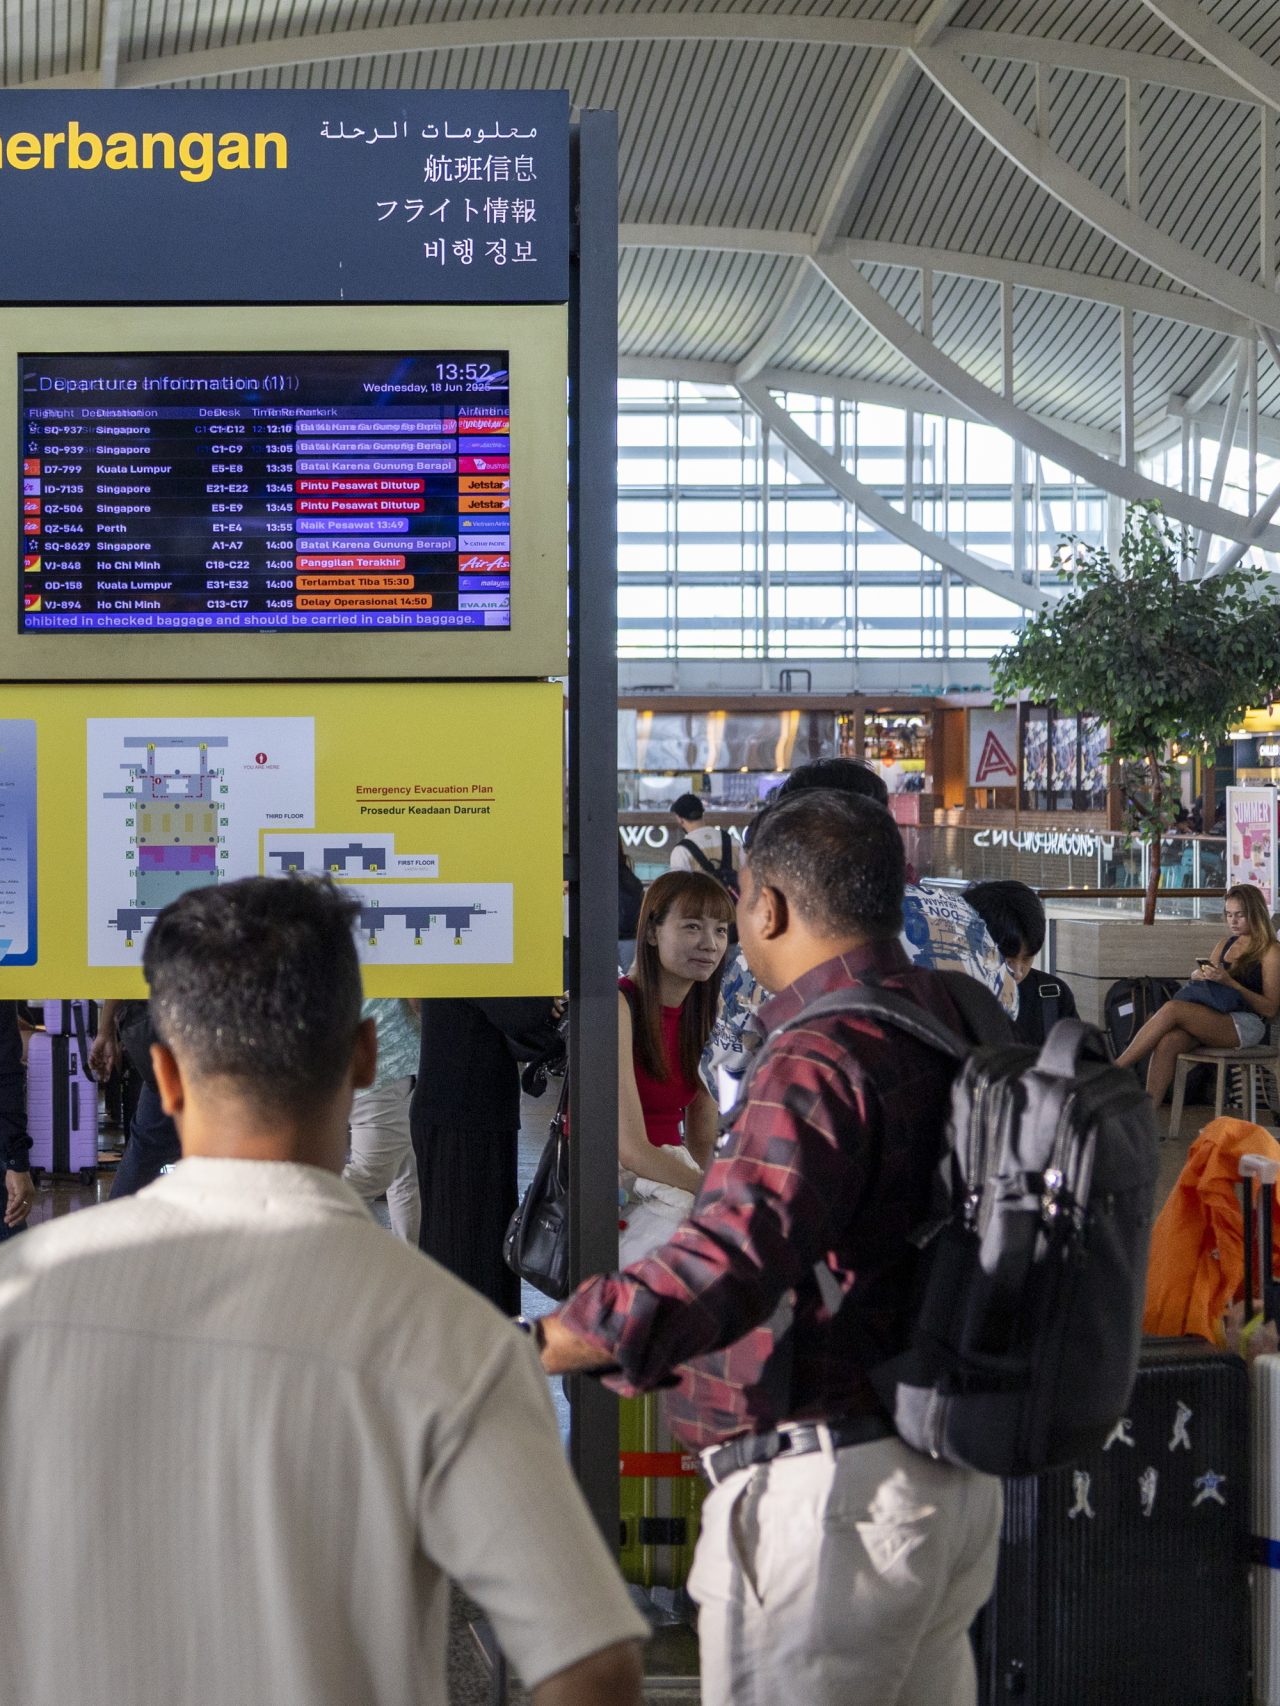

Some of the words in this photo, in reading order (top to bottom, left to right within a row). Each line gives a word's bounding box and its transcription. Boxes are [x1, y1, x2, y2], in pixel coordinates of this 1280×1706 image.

[321, 121, 406, 144] الرحلة
[422, 122, 536, 143] معلومات
[424, 155, 536, 182] 航班信息
[377, 197, 536, 223] フライト情報
[424, 238, 473, 265] 비행
[485, 238, 537, 265] 정보
[436, 364, 492, 381] 13:52
[363, 384, 427, 393] Wednesday,
[431, 383, 441, 391] 18
[468, 481, 506, 489] Jetstar
[468, 500, 506, 508] Jetstar
[45, 542, 90, 551] SQ-8629
[97, 543, 151, 551] Singapore
[266, 541, 293, 549] 14:00
[301, 541, 329, 549] Batal
[373, 541, 413, 549] Gunung
[134, 561, 160, 569] Minh
[206, 561, 249, 569] C18-C22
[301, 559, 353, 567] Panggilan
[131, 582, 172, 590] Lumpur
[266, 580, 293, 588] 14:00
[45, 601, 81, 609] VJ-894
[207, 600, 248, 608] C13-C17
[266, 600, 293, 608] 14:05
[301, 599, 331, 607] Delay
[334, 598, 398, 609] Operasional
[976, 731, 1018, 782] A
[356, 786, 411, 796] Emergency
[415, 785, 468, 793] Evacuation
[472, 785, 492, 793] Plan
[409, 806, 450, 814] Keadaan
[454, 806, 490, 814] Darurat
[1233, 800, 1268, 823] SUMMER
